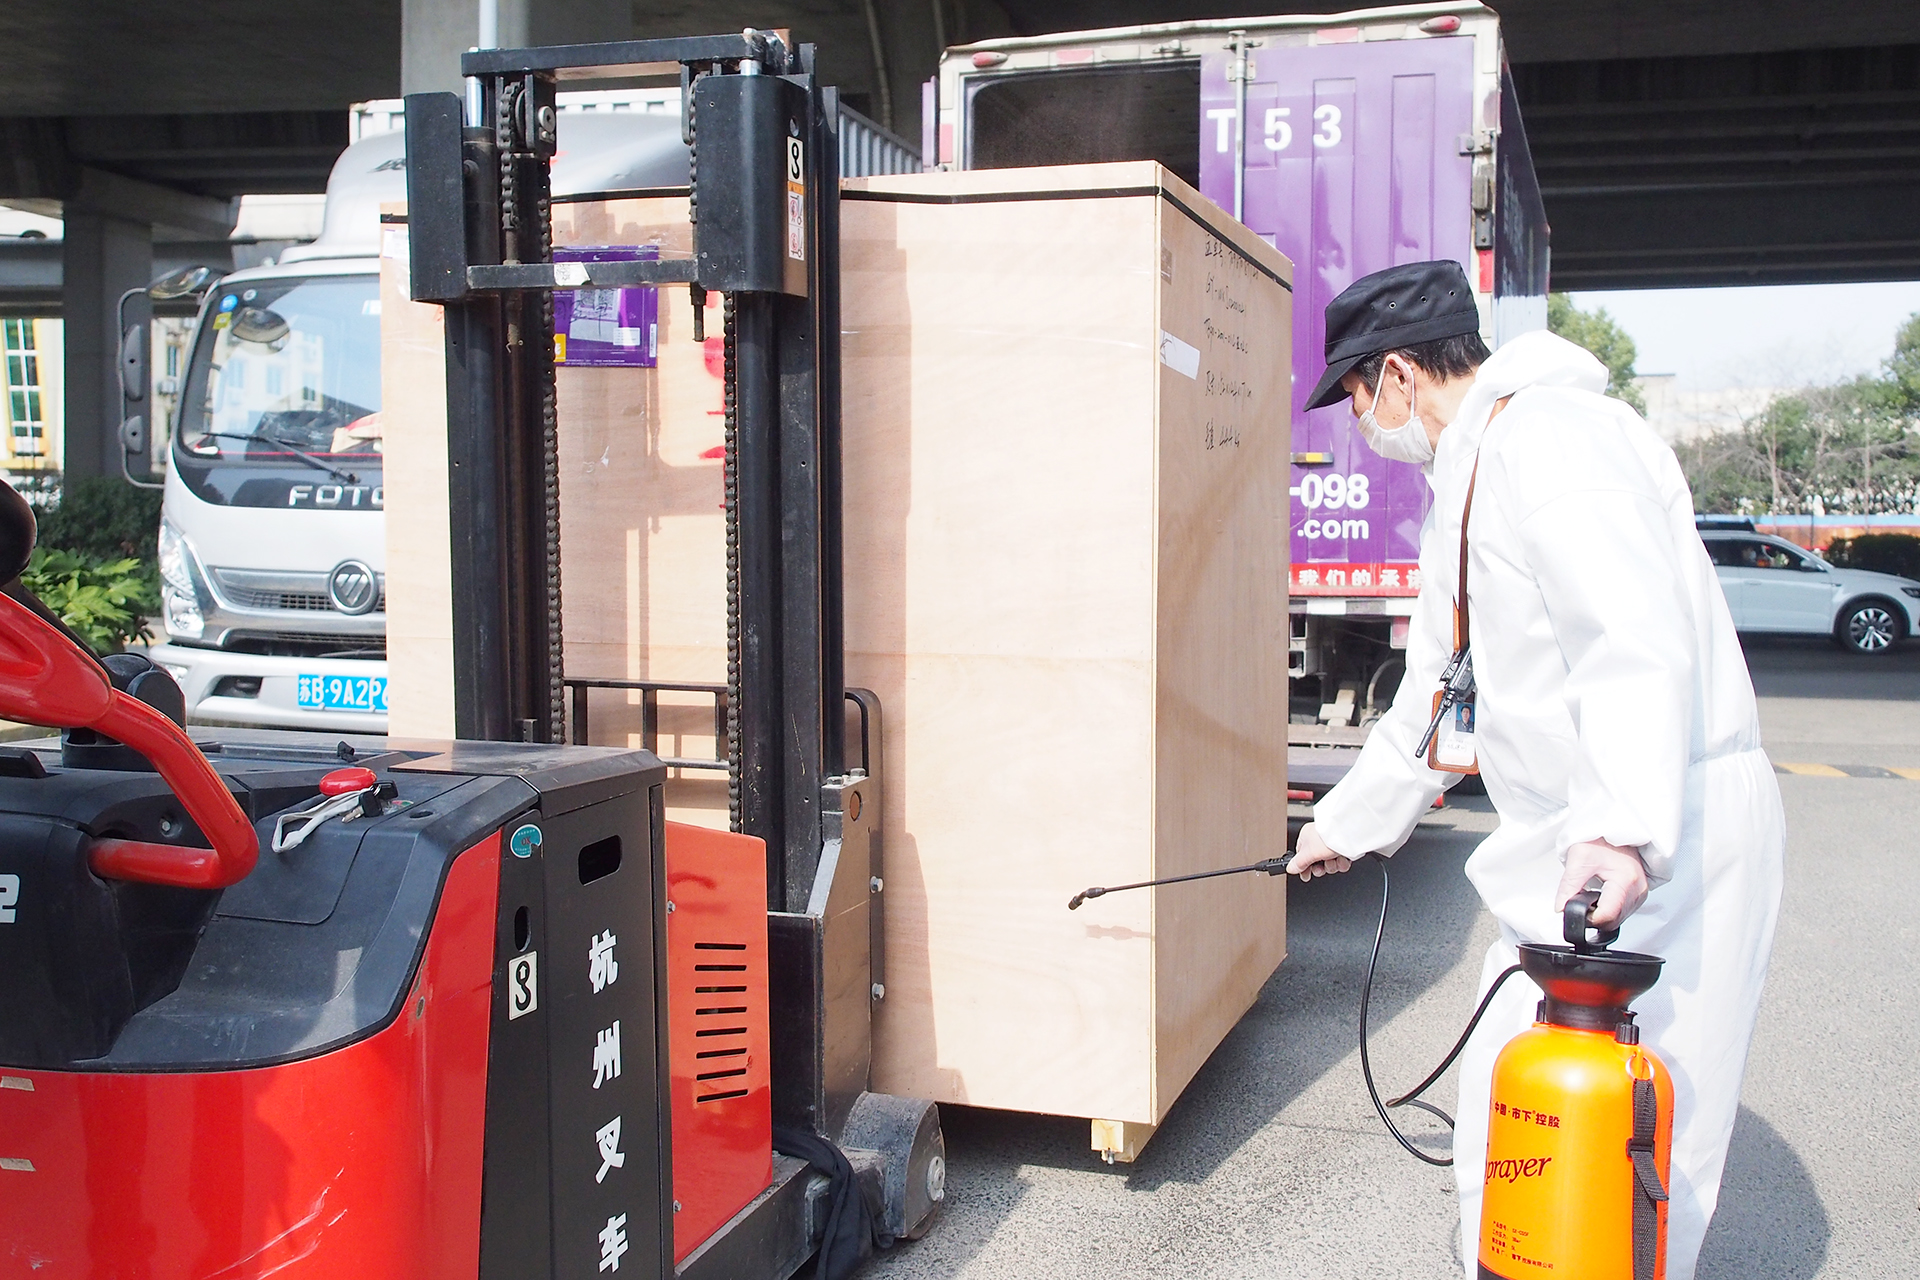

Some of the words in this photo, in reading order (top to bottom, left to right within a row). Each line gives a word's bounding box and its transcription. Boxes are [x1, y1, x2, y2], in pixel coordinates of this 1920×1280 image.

[1206, 108, 1237, 153] T
[1264, 108, 1292, 150] 5
[1313, 104, 1342, 148] 3
[1297, 519, 1370, 540] .com
[1290, 568, 1425, 590] 我们的承诺
[588, 928, 630, 1274] 杭州叉车
[1485, 1145, 1552, 1185] prayer
